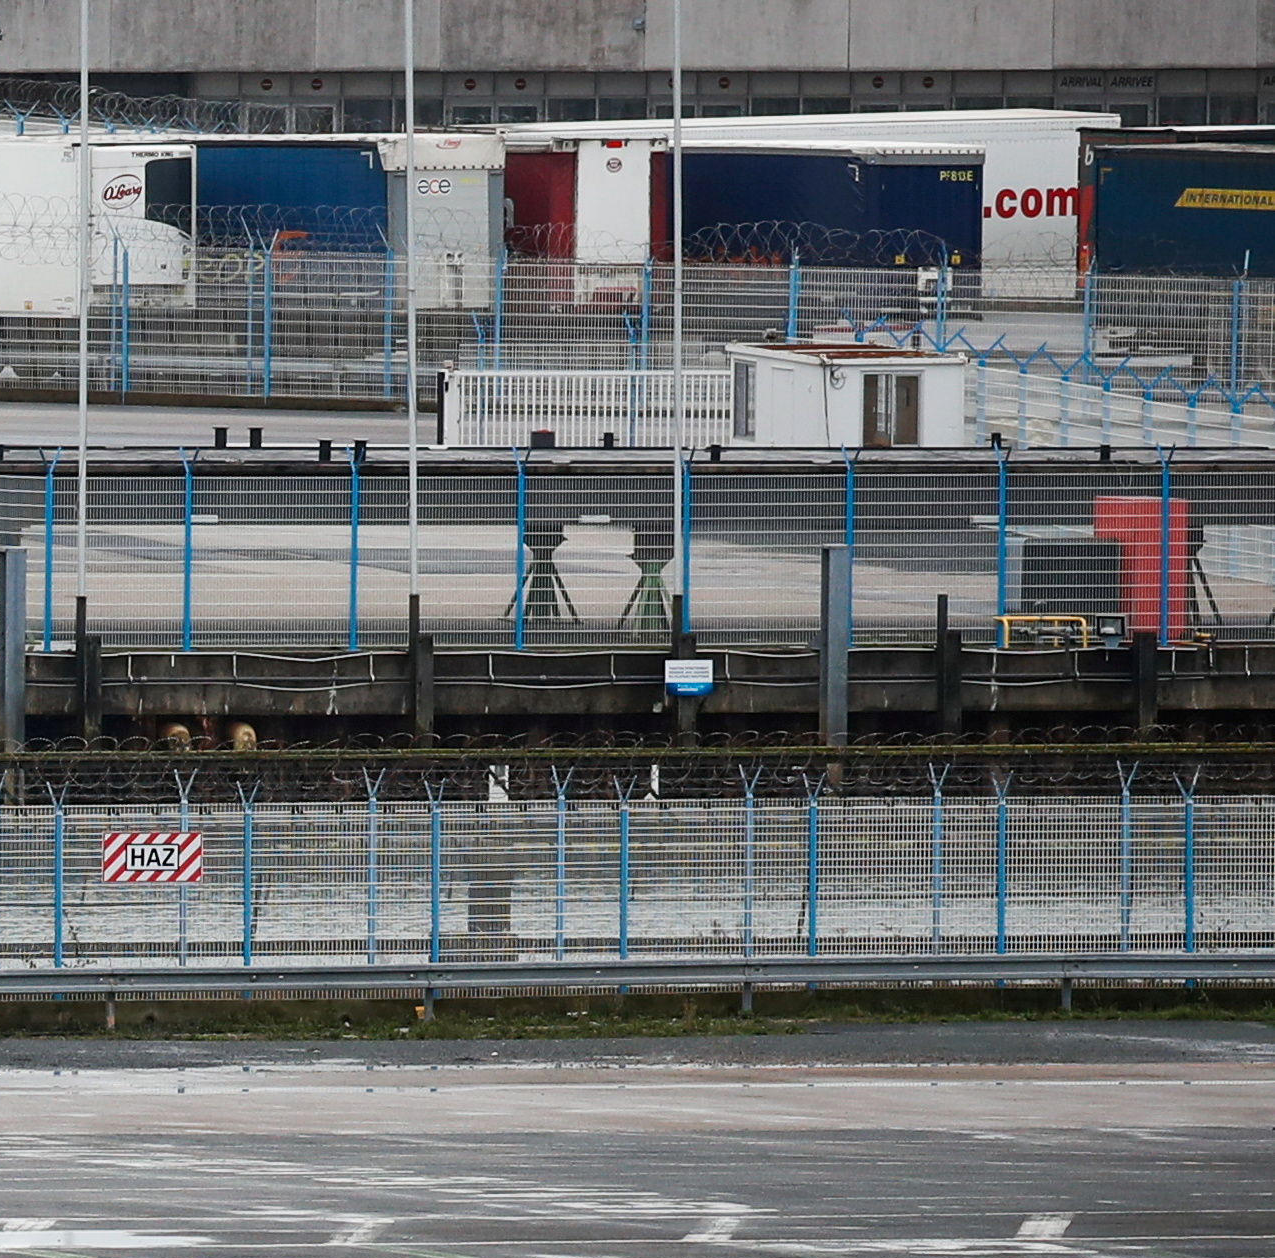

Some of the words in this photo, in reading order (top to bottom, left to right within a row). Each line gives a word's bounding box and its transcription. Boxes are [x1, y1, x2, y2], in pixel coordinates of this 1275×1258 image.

[1060, 75, 1102, 88] ARRIVAL
[103, 184, 142, 201] O'Leary
[417, 179, 451, 195] ace
[1185, 193, 1274, 206] INTERNATIONAL
[131, 848, 175, 867] HAZ
